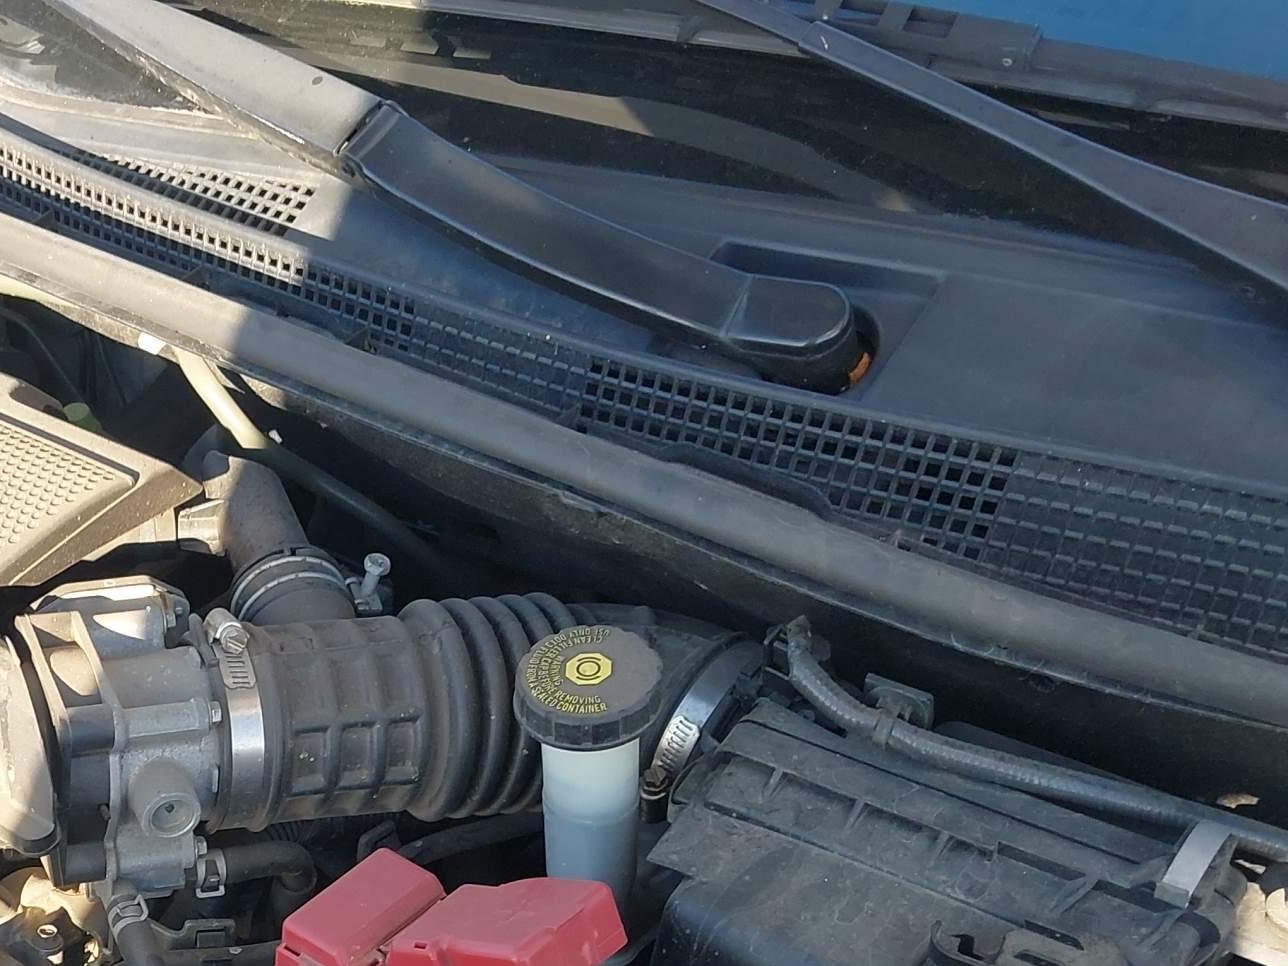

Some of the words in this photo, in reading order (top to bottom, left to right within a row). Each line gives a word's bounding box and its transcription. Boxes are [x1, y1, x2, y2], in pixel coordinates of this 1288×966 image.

[531, 685, 557, 707] SEALED
[556, 701, 608, 714] CONTAINER
[556, 690, 601, 704] REMOVING
